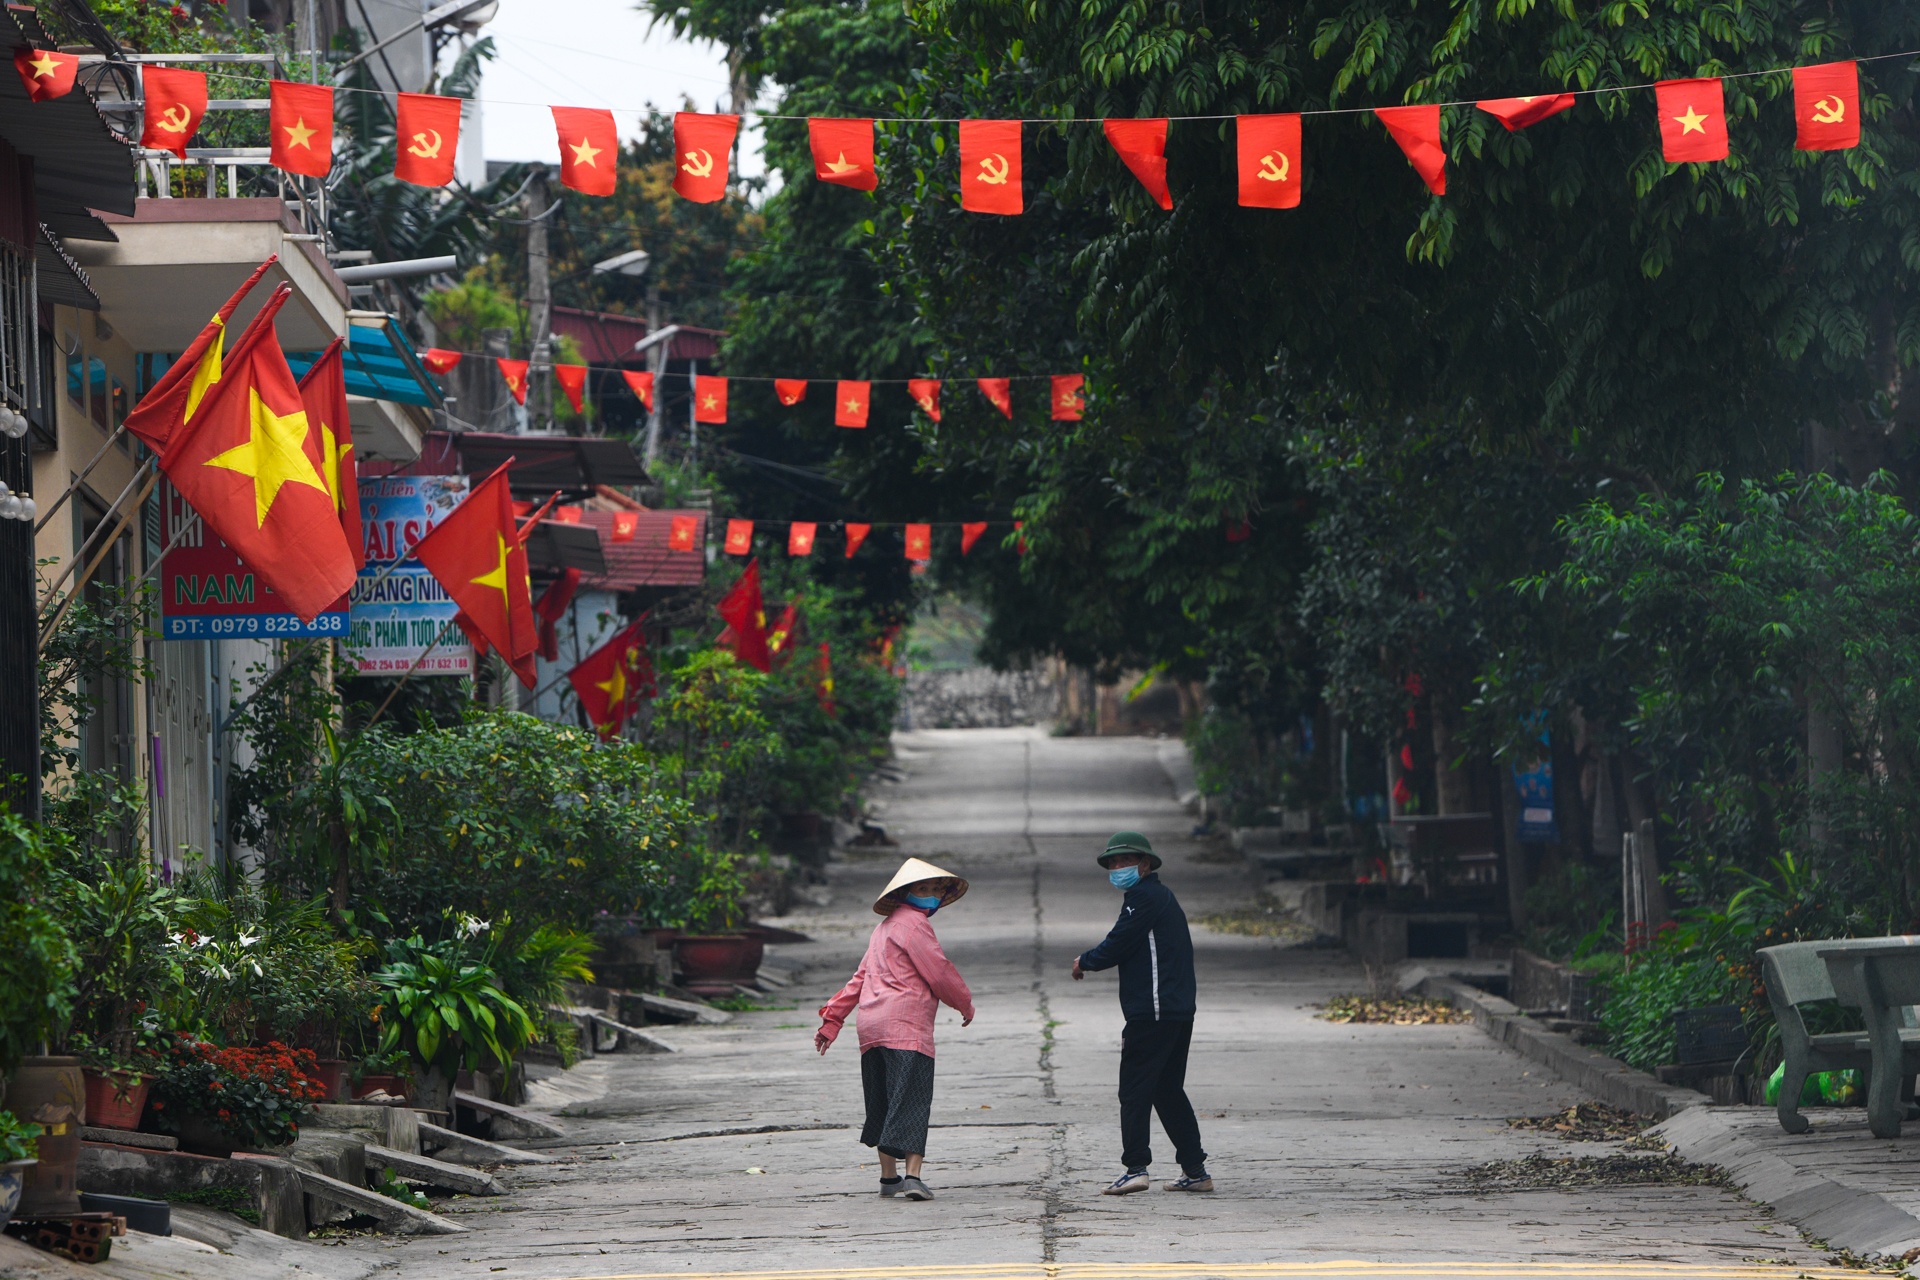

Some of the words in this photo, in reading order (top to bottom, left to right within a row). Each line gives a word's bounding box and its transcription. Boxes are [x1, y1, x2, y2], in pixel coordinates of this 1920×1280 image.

[380, 480, 415, 496] Liên
[175, 574, 255, 605] NAM
[171, 619, 204, 634] ĐT:
[211, 618, 259, 634] 0979
[264, 617, 301, 632] 825
[306, 615, 342, 632] 838
[375, 609, 407, 648] PHẨM
